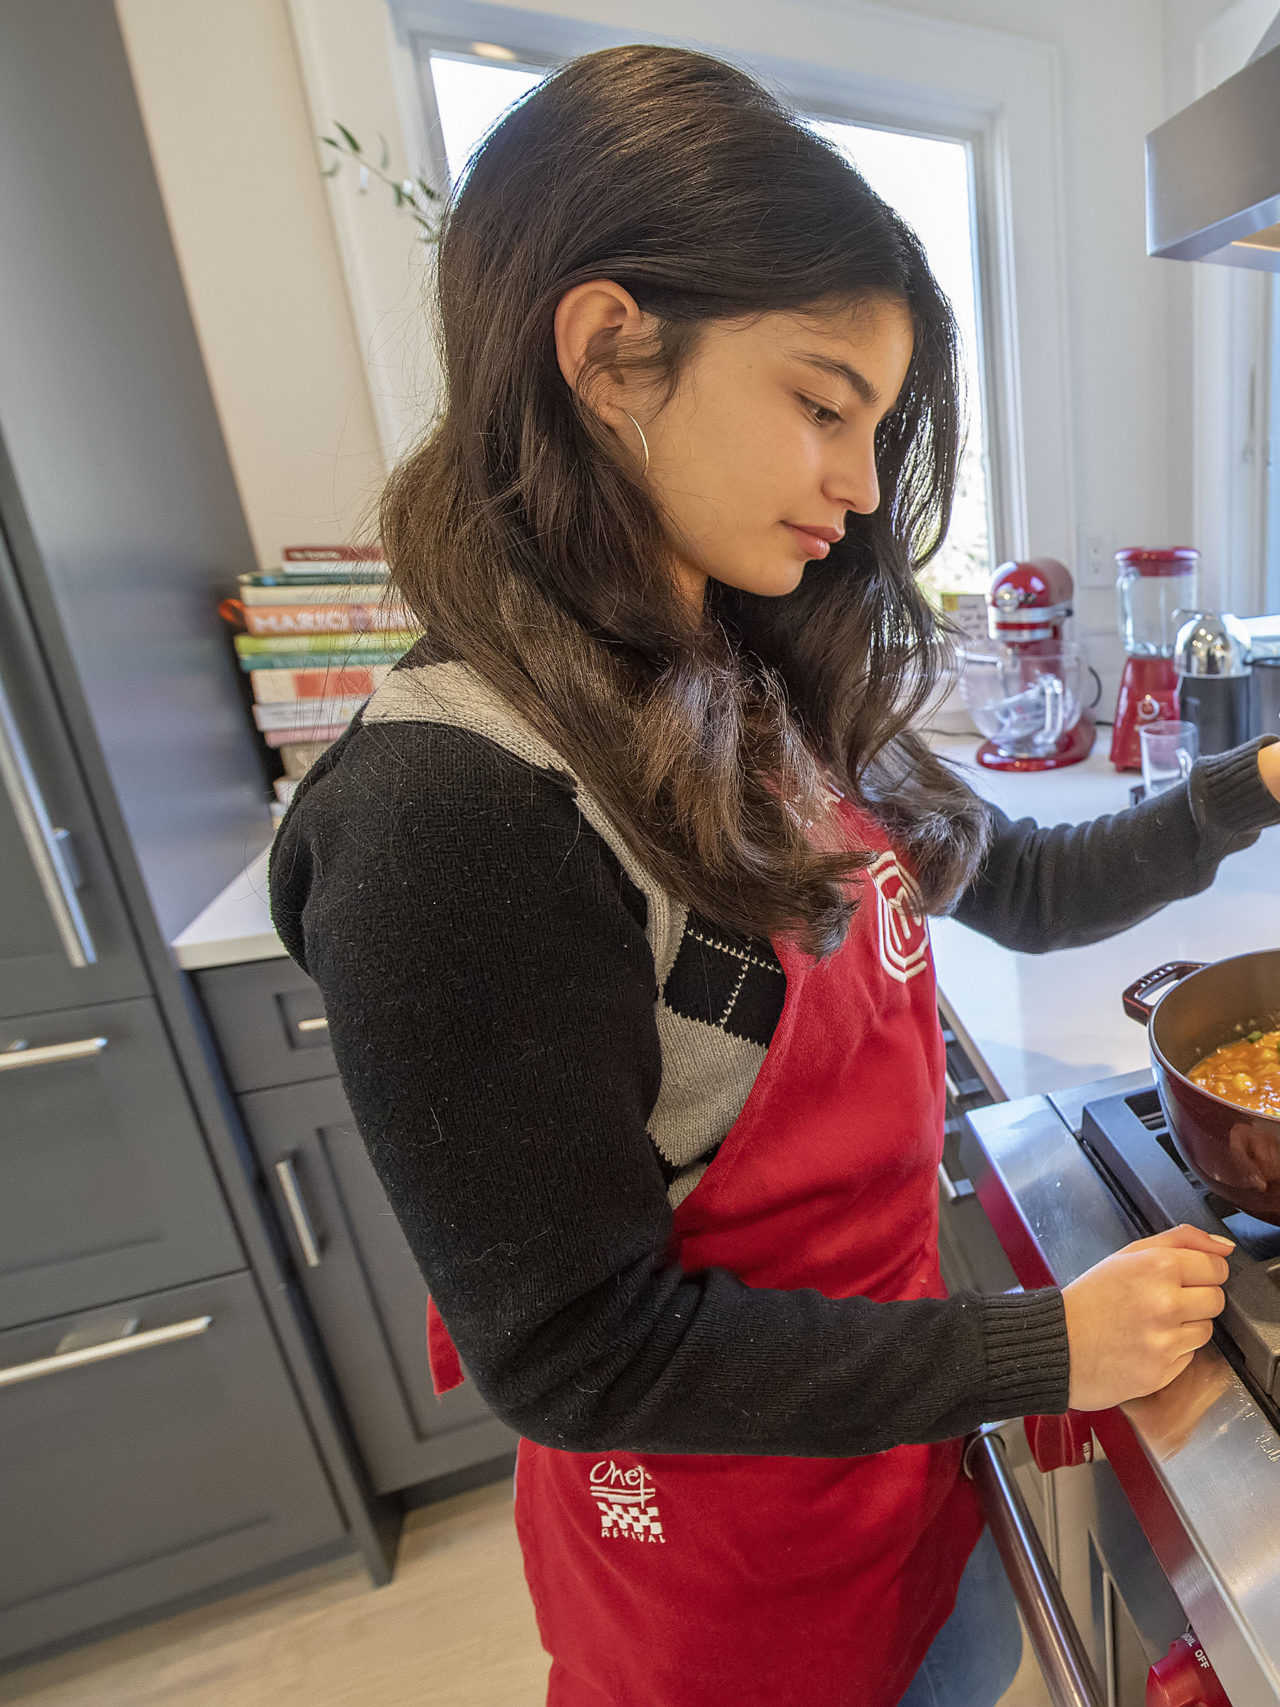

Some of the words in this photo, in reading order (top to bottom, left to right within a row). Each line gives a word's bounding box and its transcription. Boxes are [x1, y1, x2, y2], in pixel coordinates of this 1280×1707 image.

[589, 1460, 652, 1509] Chef
[601, 1528, 666, 1543] REVIVAL
[1194, 1649, 1211, 1669] OFF
